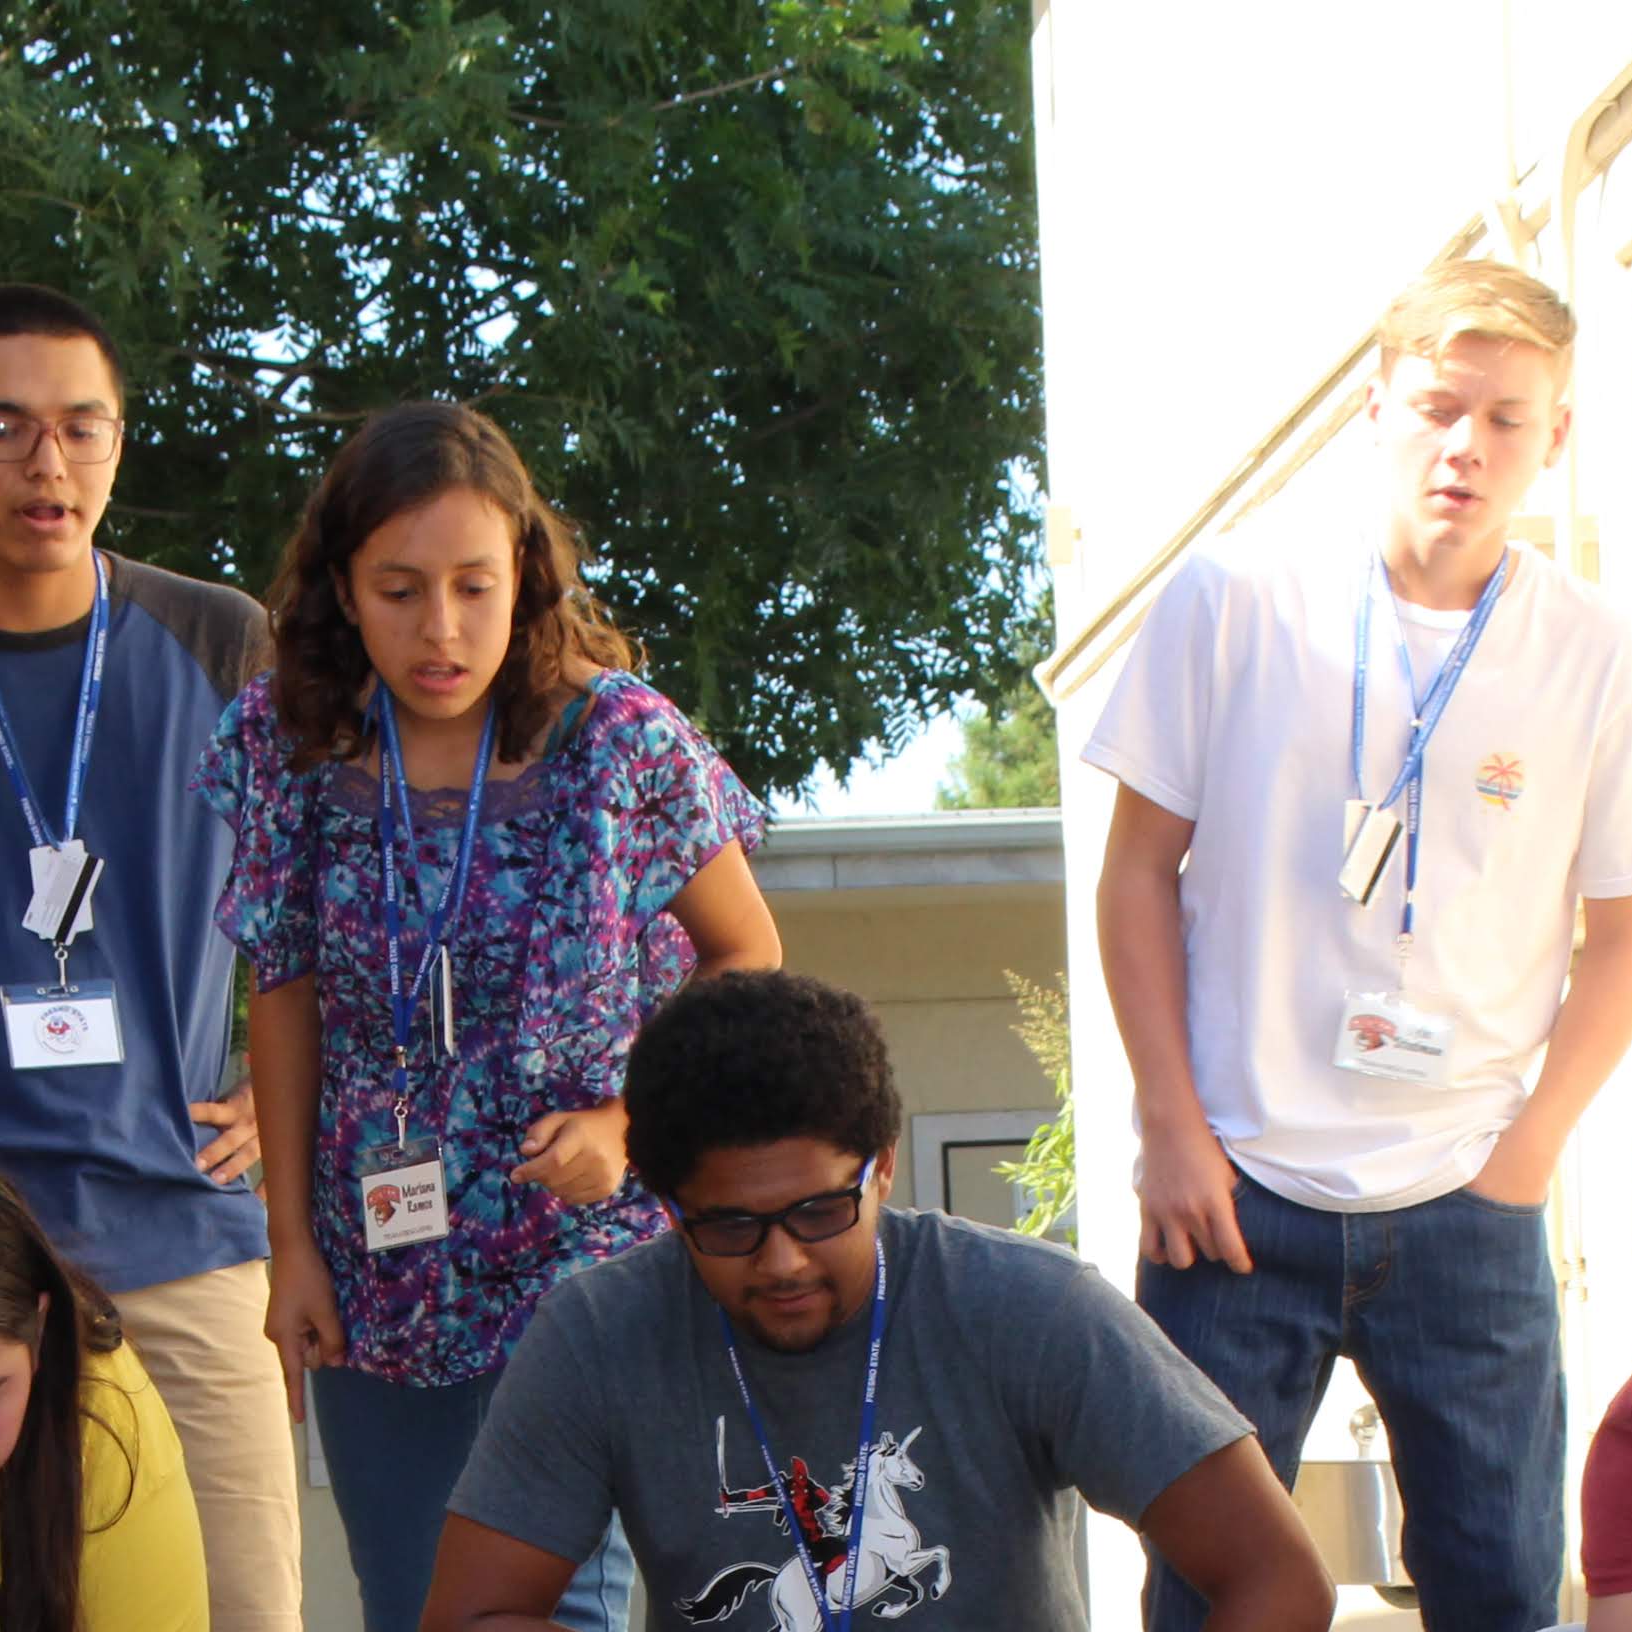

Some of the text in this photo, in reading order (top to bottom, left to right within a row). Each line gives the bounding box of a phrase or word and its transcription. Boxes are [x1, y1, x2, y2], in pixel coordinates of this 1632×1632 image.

[876, 1266, 886, 1300] FRESNO
[865, 1368, 878, 1403] FRESNO
[855, 1472, 866, 1507] FRESNO
[841, 1575, 853, 1611] FRESNO
